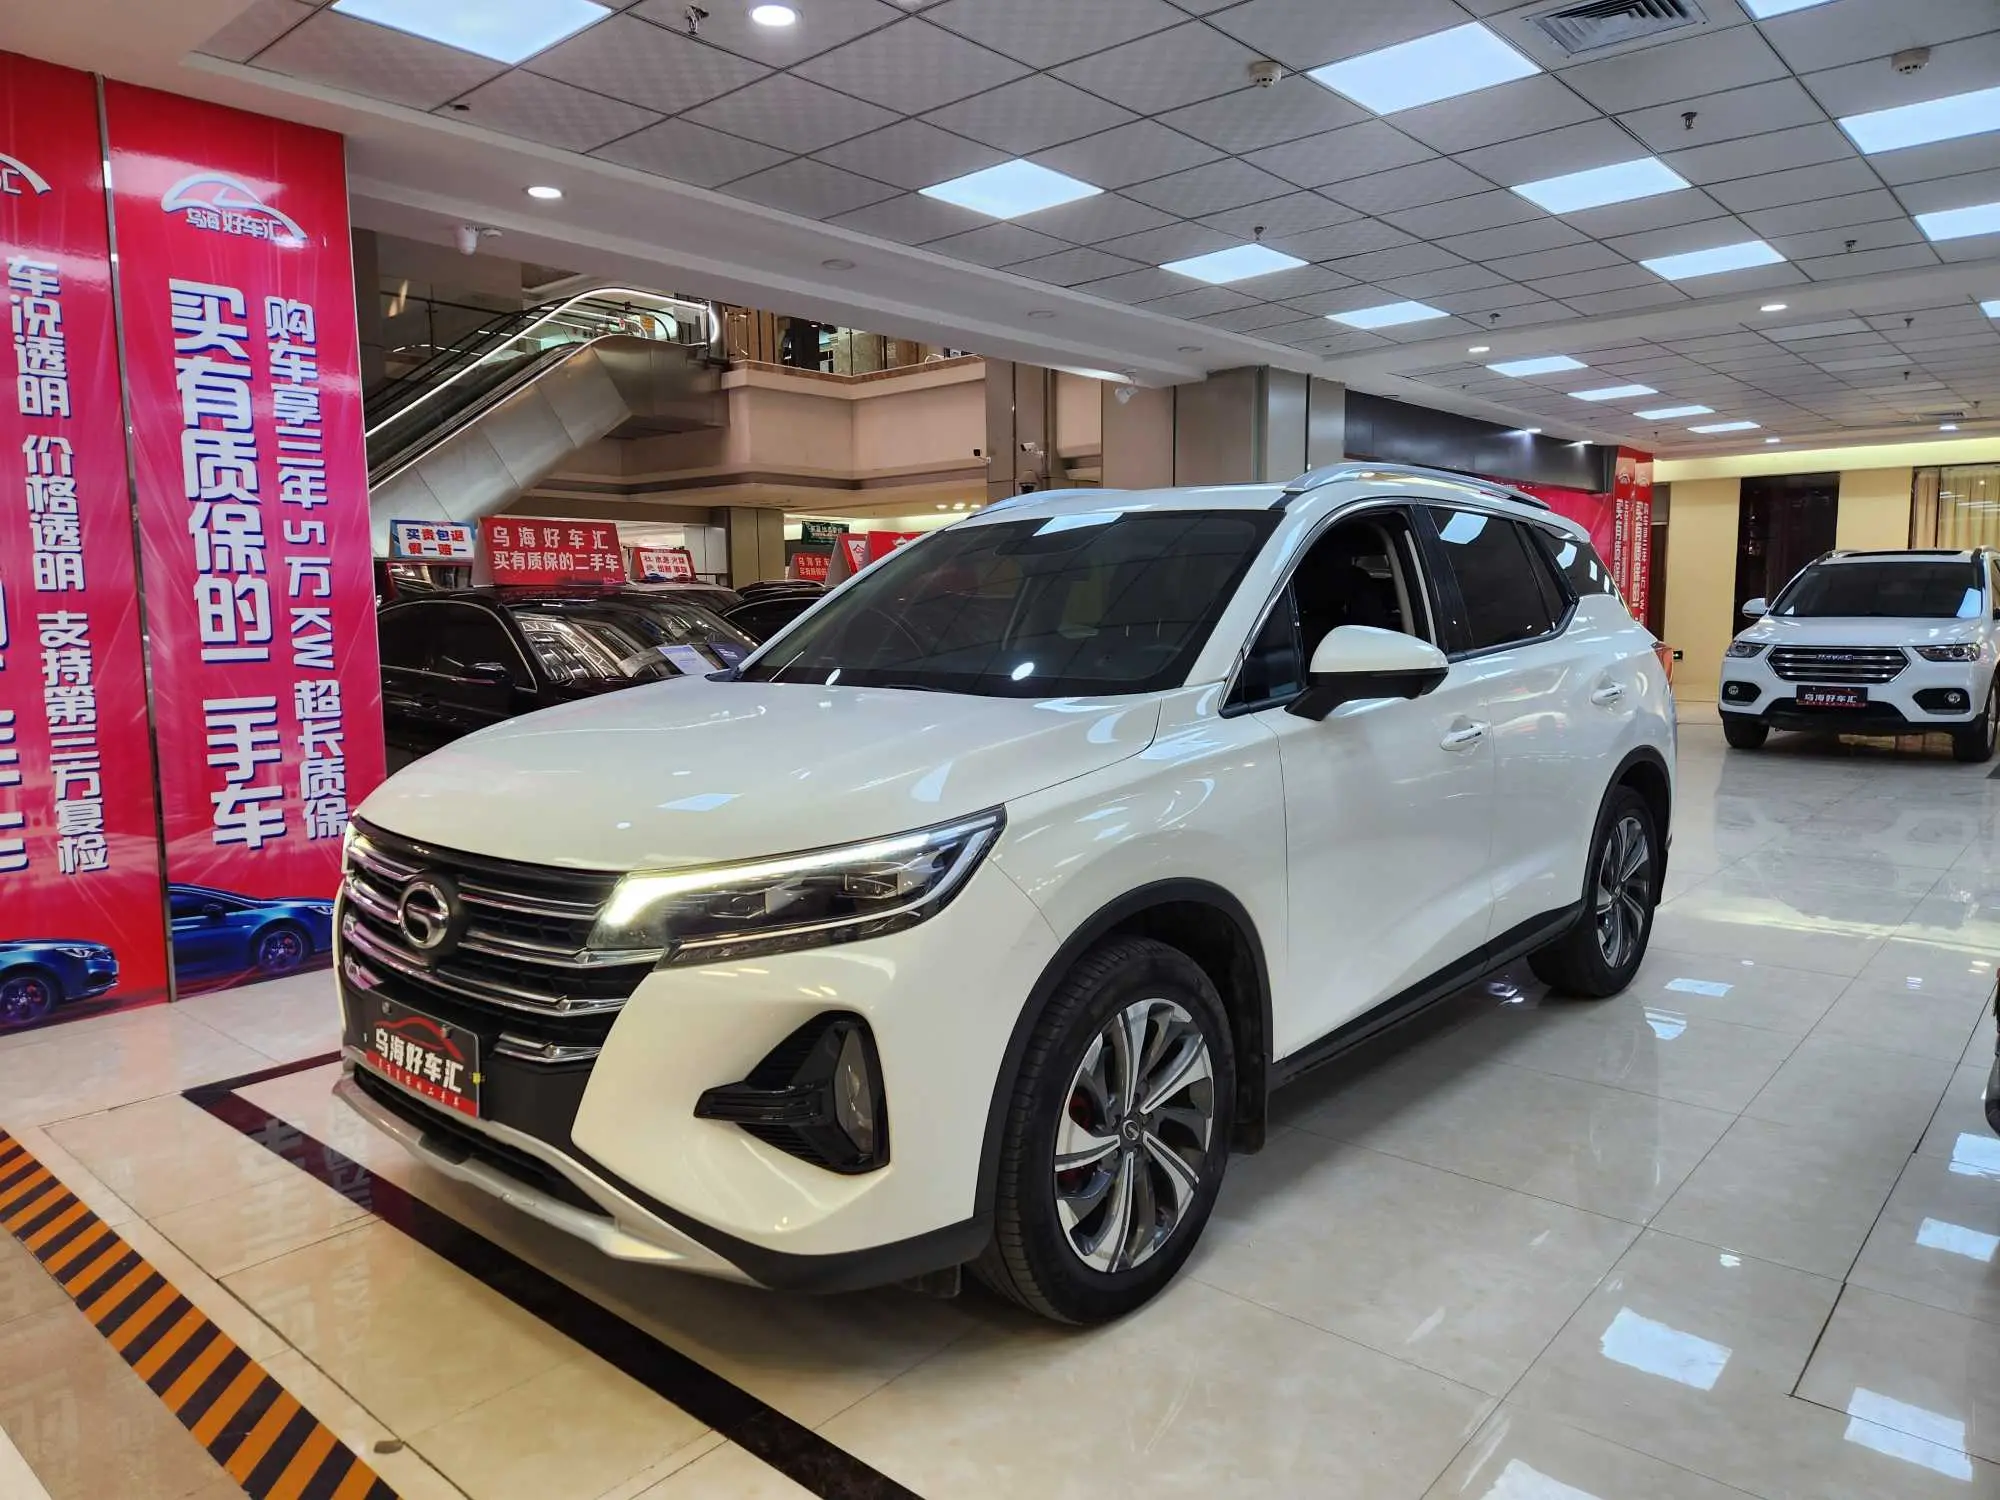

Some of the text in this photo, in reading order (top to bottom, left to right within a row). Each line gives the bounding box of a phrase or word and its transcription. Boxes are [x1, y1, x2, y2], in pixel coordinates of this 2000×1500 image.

[7, 255, 109, 875] 车况透明 价格透明 支持第三方复检
[168, 277, 288, 850] 买有质保的二手车
[493, 525, 610, 550] 乌海好车汇
[493, 551, 620, 572] 买有质保的二手车
[375, 1028, 463, 1093] 乌海好车汇
